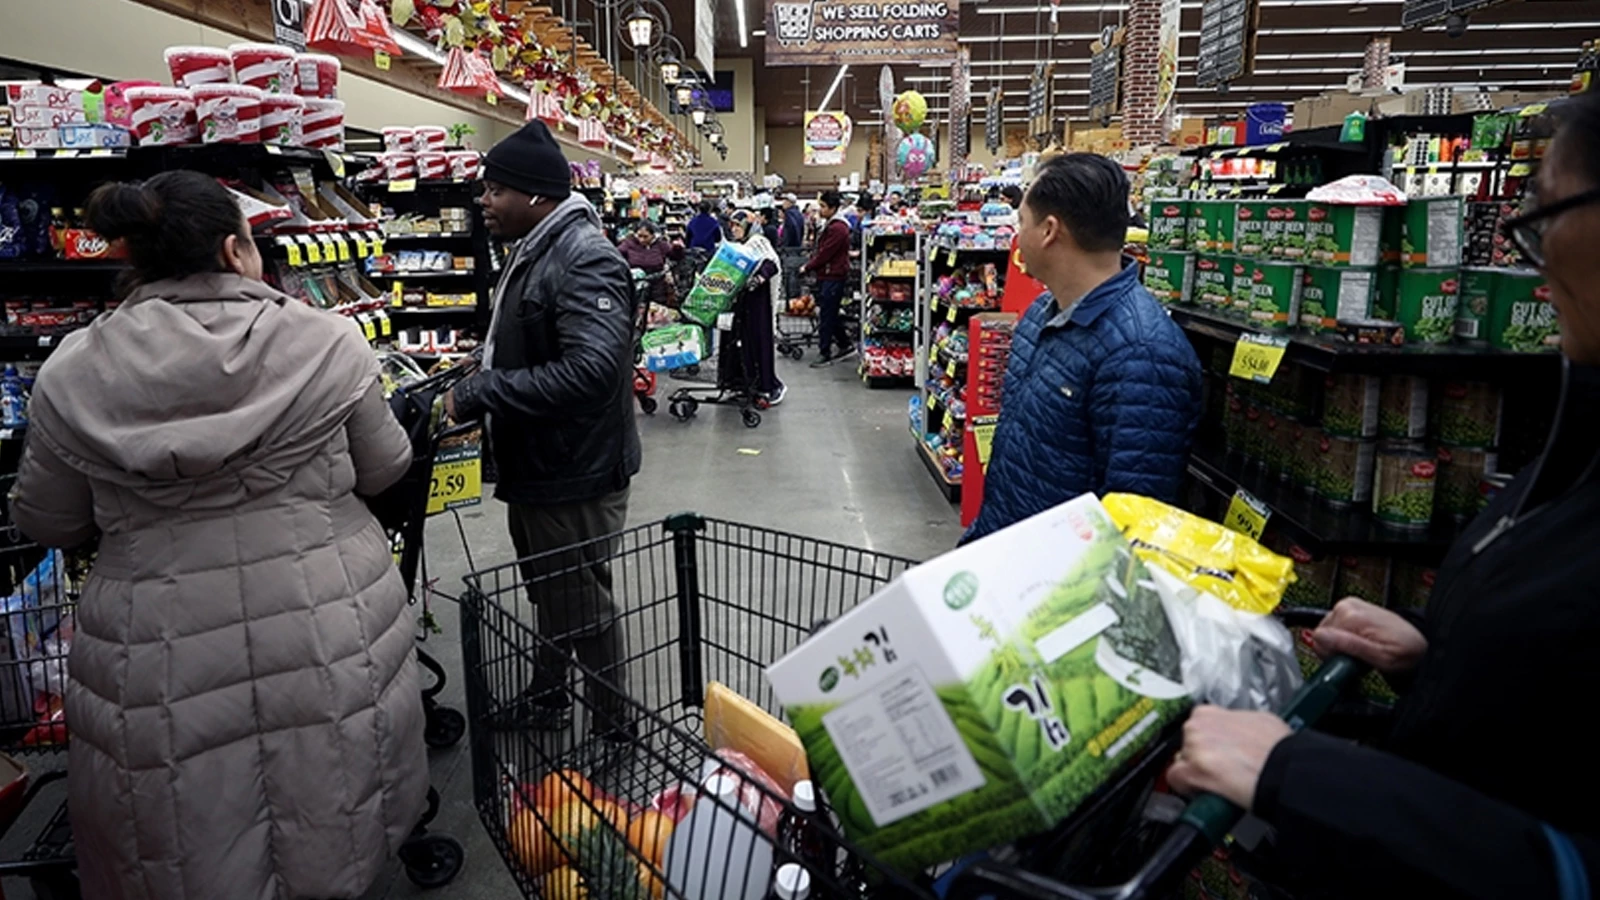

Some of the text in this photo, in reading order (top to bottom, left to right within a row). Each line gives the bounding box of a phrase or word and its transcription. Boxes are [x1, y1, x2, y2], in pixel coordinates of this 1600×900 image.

[823, 3, 947, 19] WE SELL FOLDING
[815, 24, 939, 40] SHOPPING CARTS
[430, 473, 465, 497] 2.59
[1005, 676, 1069, 748] 김
